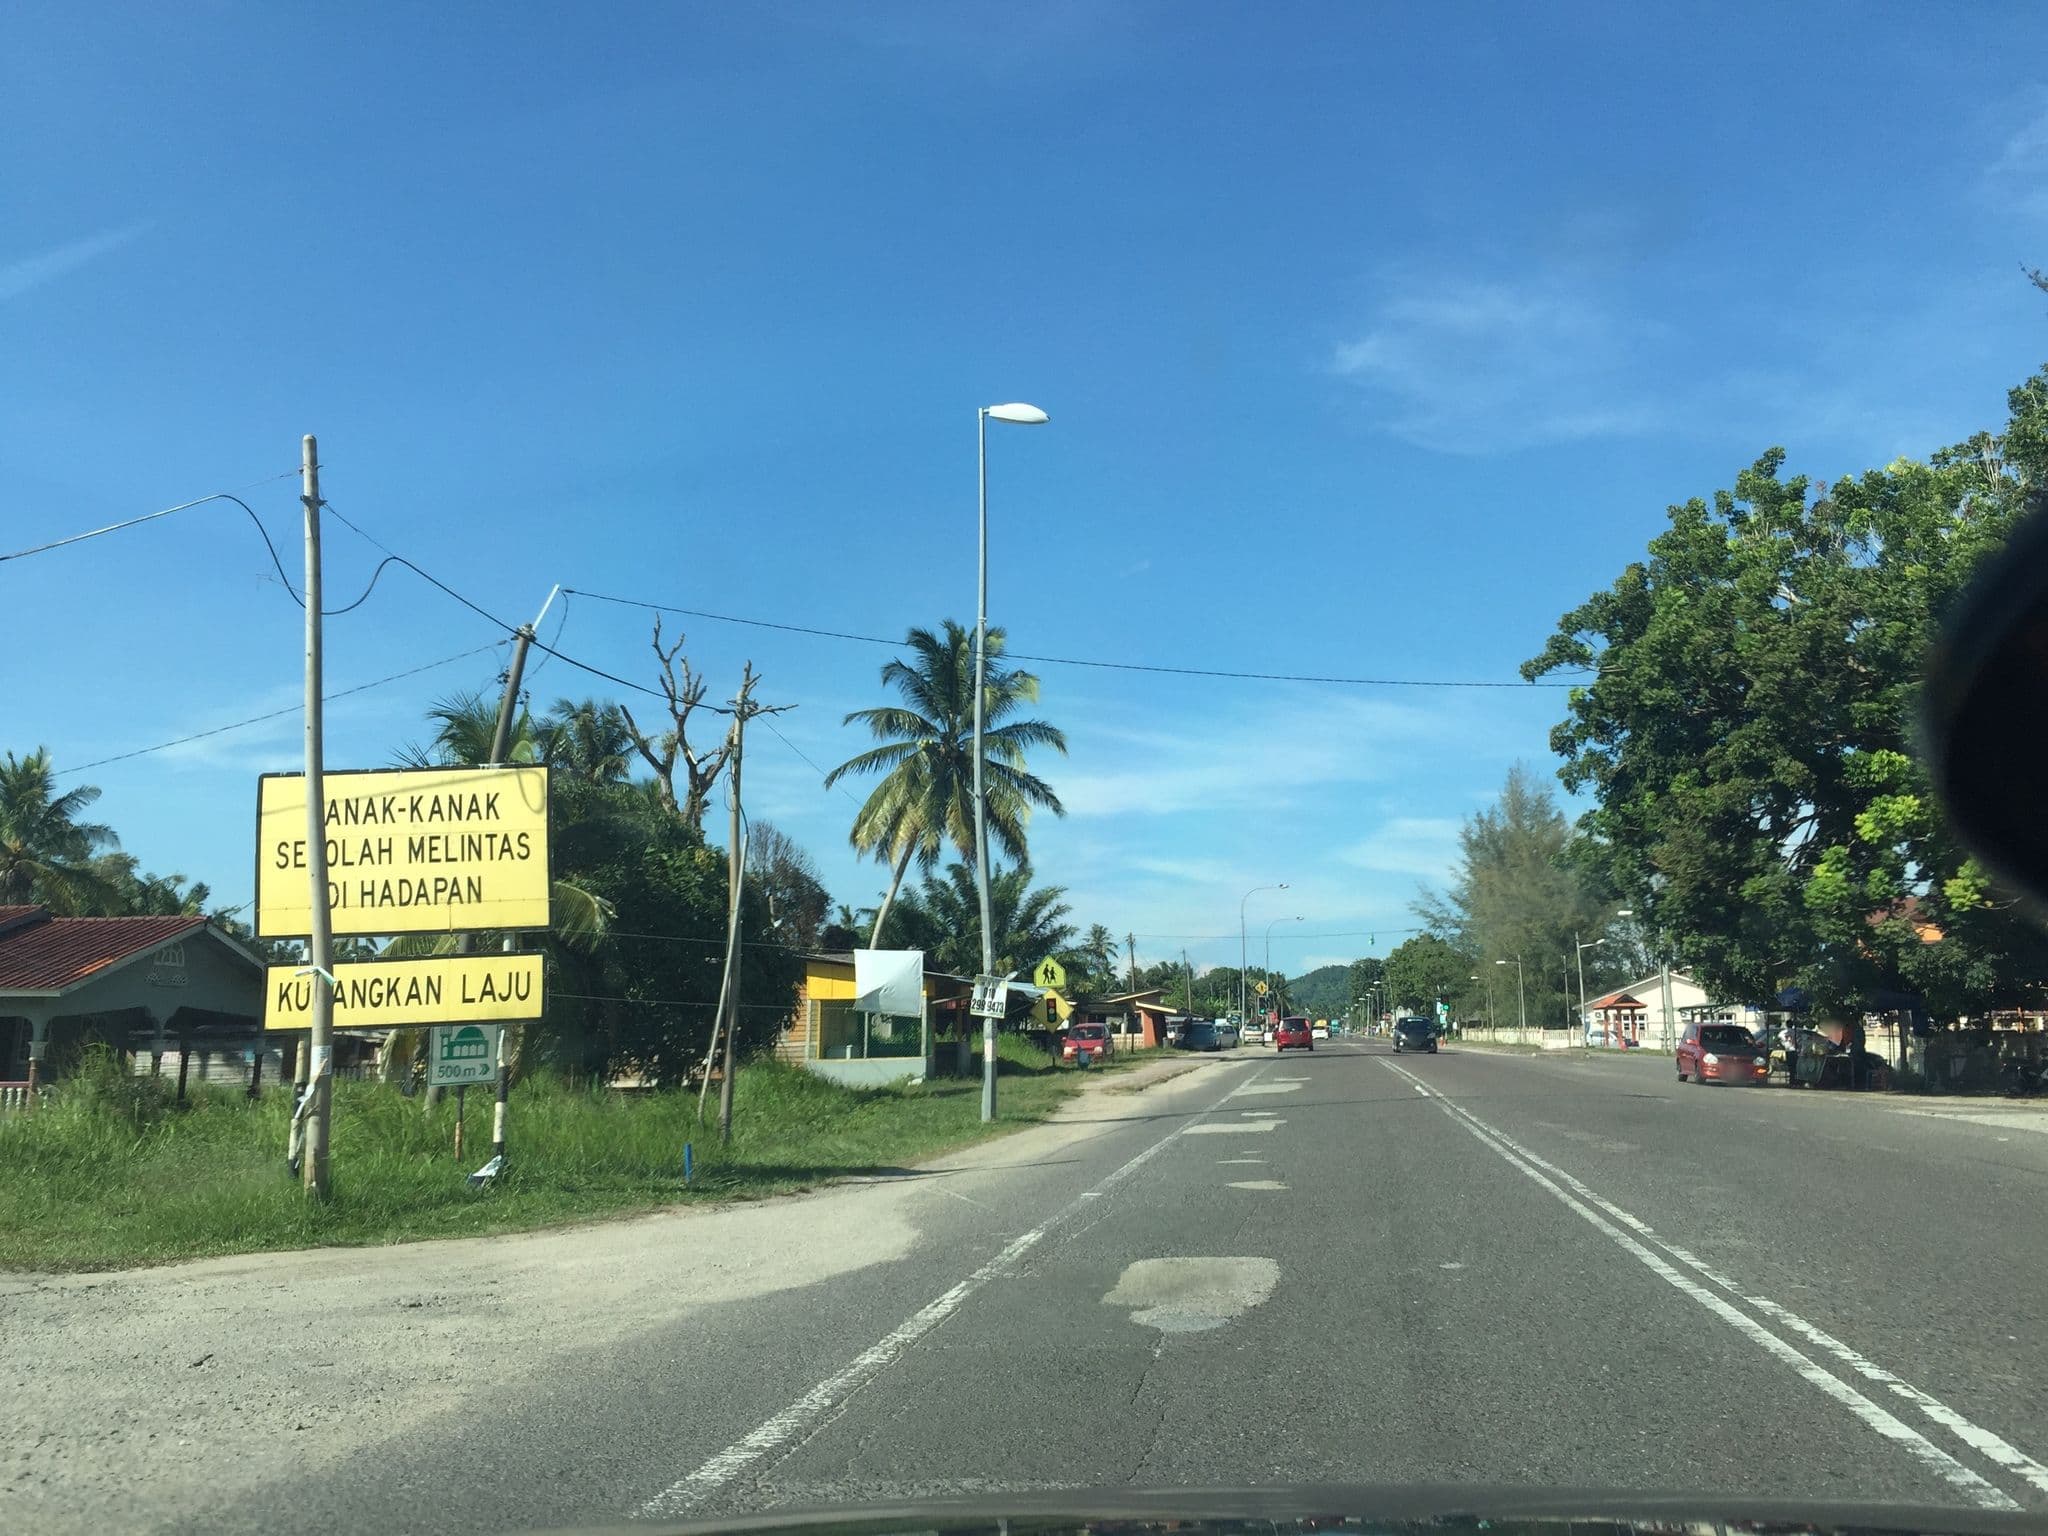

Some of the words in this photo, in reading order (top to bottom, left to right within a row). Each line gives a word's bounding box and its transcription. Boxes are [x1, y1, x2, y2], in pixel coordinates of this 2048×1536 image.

[324, 792, 500, 826] ANAK-KANAK
[275, 836, 393, 869] SEOLAH
[408, 832, 531, 864] MELINTAS
[360, 876, 482, 909] HADAPAN
[278, 975, 442, 1013] KUANGKAN
[461, 971, 531, 1005] LAJU
[438, 1065, 461, 1078] 500
[463, 1067, 476, 1077] m
